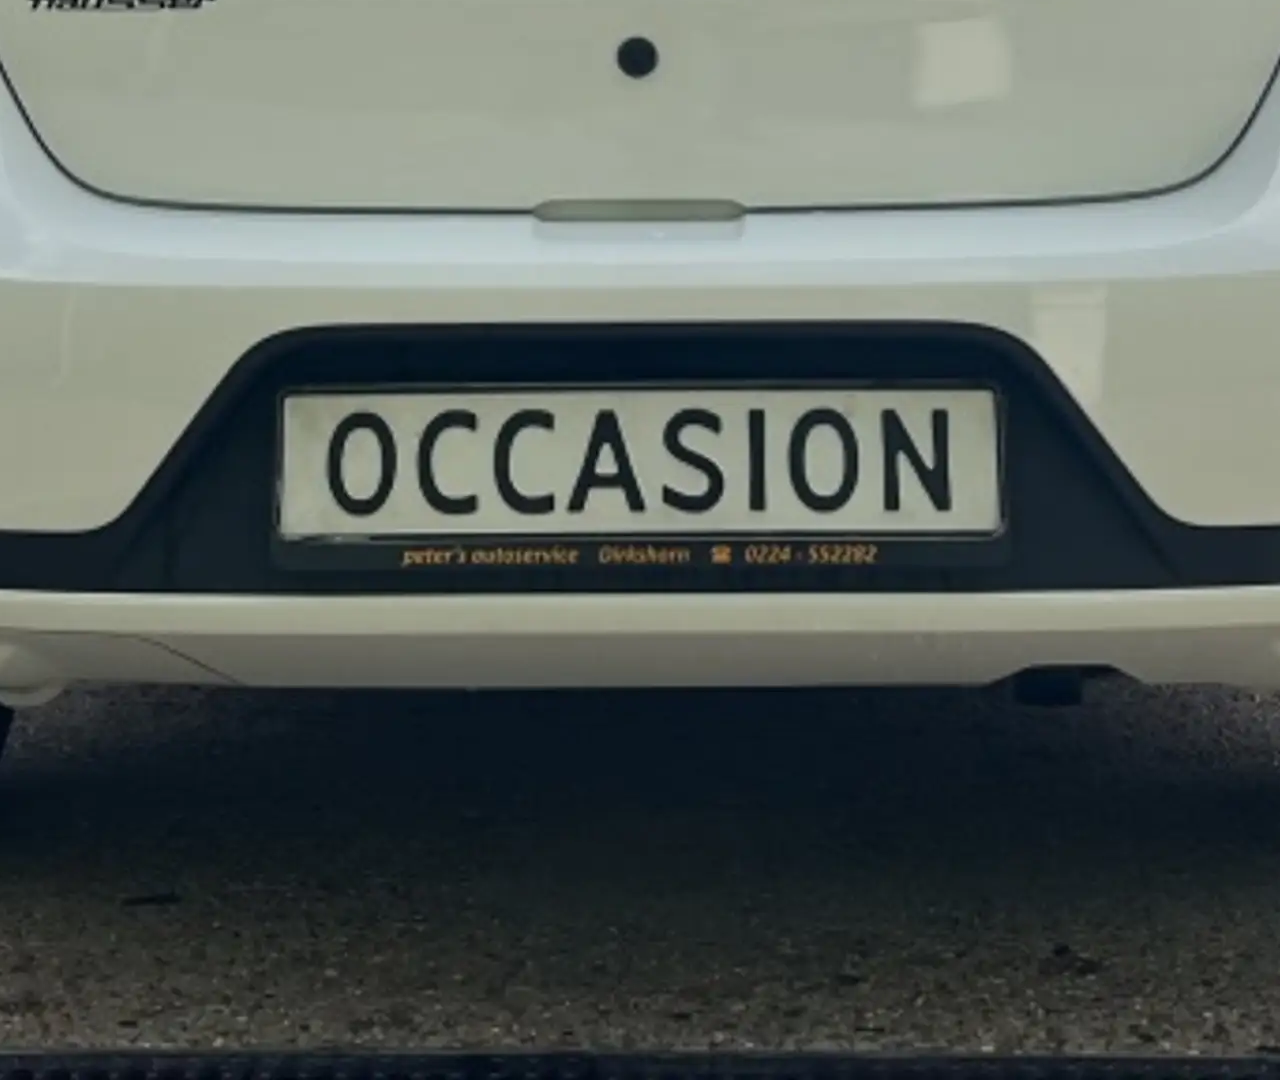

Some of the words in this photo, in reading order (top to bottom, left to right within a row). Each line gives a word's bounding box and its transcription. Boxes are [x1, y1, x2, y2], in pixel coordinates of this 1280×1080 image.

[326, 407, 953, 517] OCCASION
[471, 546, 580, 565] autoservice
[744, 544, 792, 563] 0224
